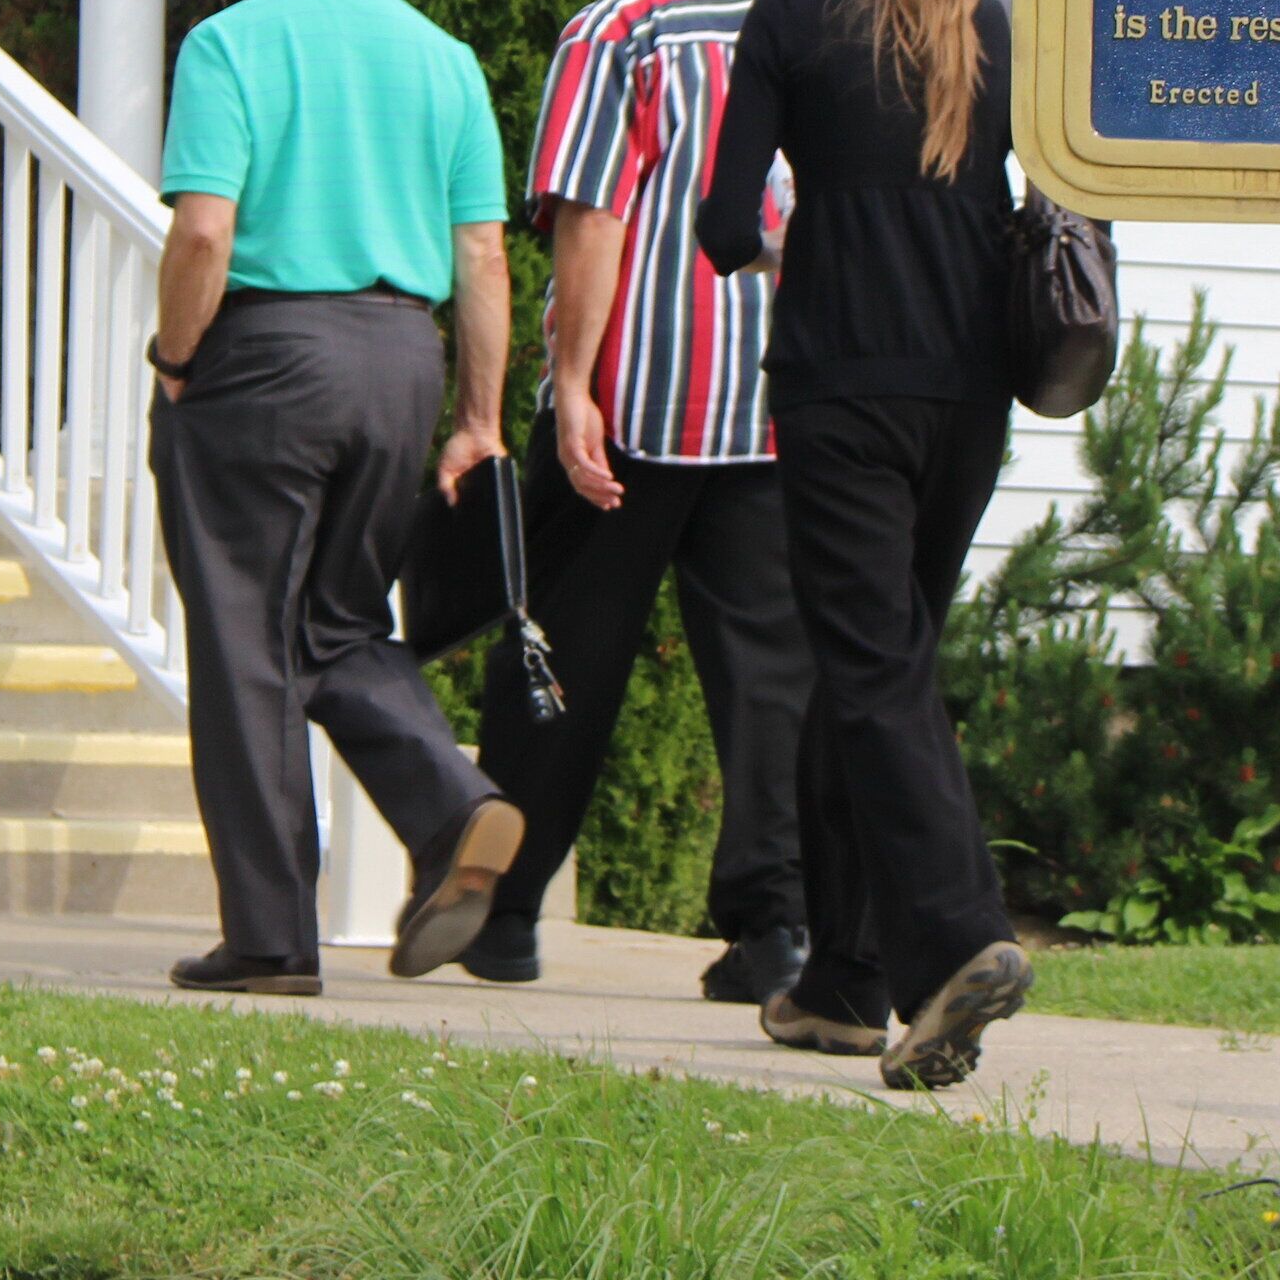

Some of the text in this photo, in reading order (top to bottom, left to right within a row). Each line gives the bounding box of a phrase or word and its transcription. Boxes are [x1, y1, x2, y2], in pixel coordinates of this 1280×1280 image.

[1113, 4, 1148, 40] is
[1158, 5, 1219, 42] the
[1150, 78, 1260, 106] Erected
